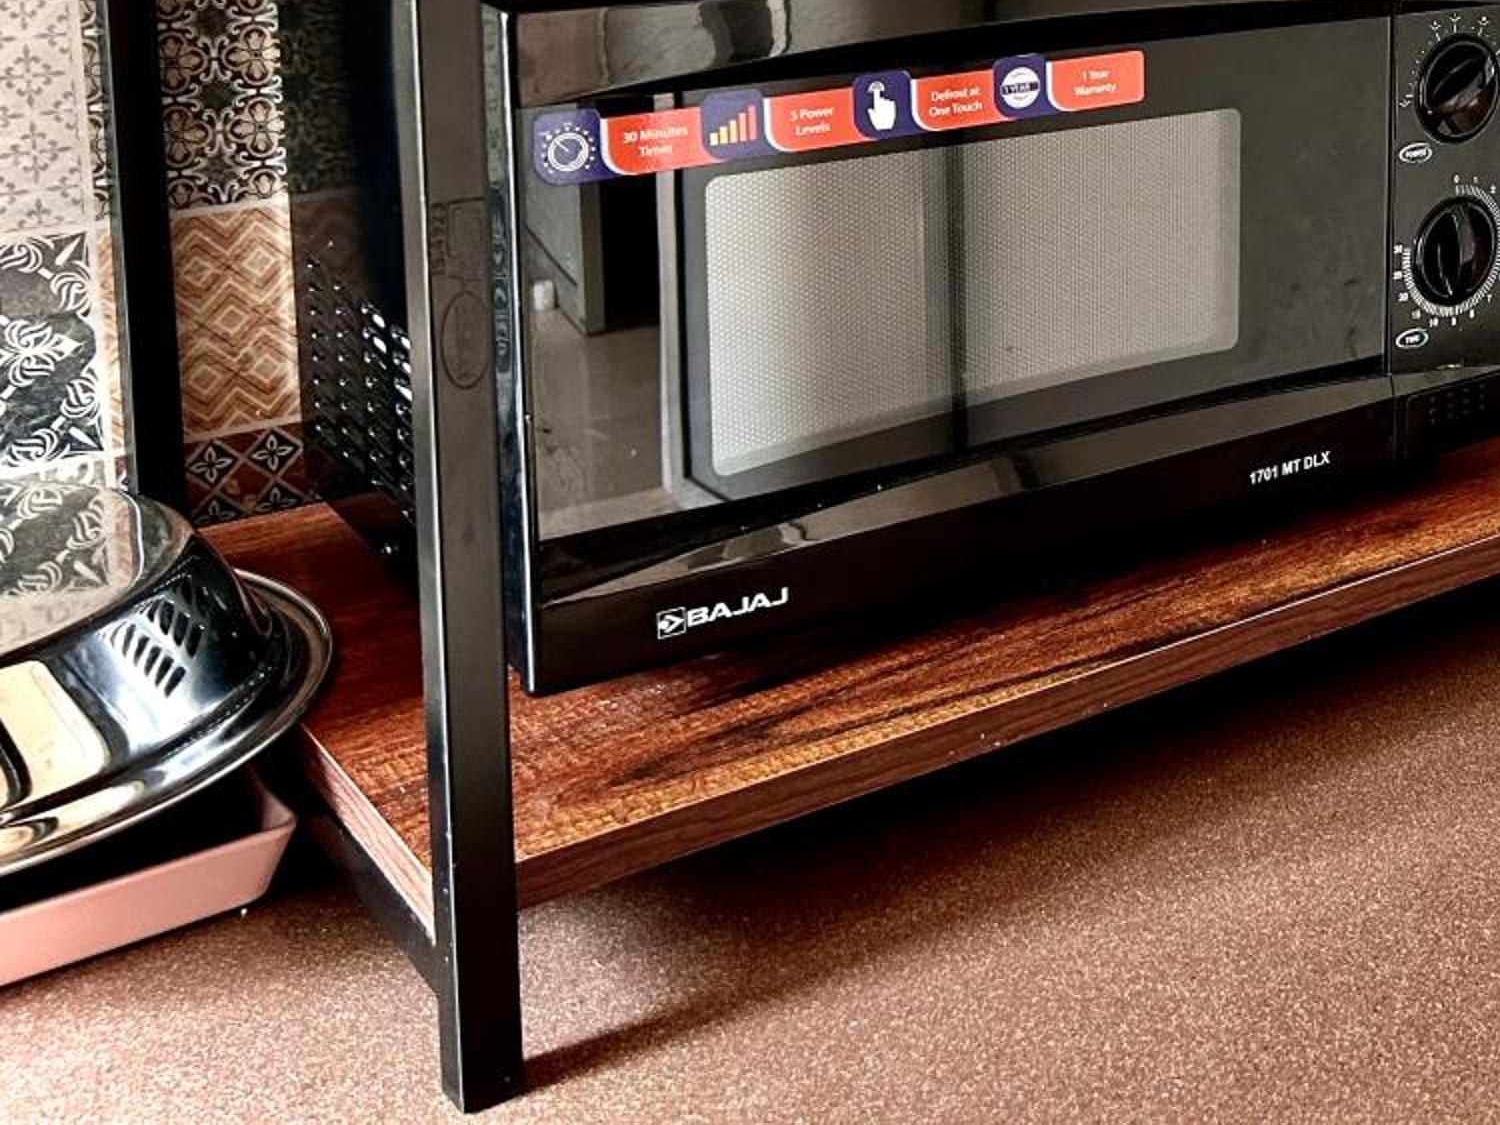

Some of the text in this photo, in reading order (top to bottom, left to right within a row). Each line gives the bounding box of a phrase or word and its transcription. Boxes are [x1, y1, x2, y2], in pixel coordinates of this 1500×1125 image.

[930, 87, 967, 102] Defrost
[1073, 83, 1118, 97] Warranty
[799, 106, 834, 120] Power
[928, 101, 983, 117] One Touch
[623, 125, 689, 145] 30 Minutes
[794, 123, 832, 137] Levels
[639, 142, 674, 157] Timer
[1249, 450, 1332, 485] 1701 MT DLX
[687, 586, 789, 628] BAJAJ
